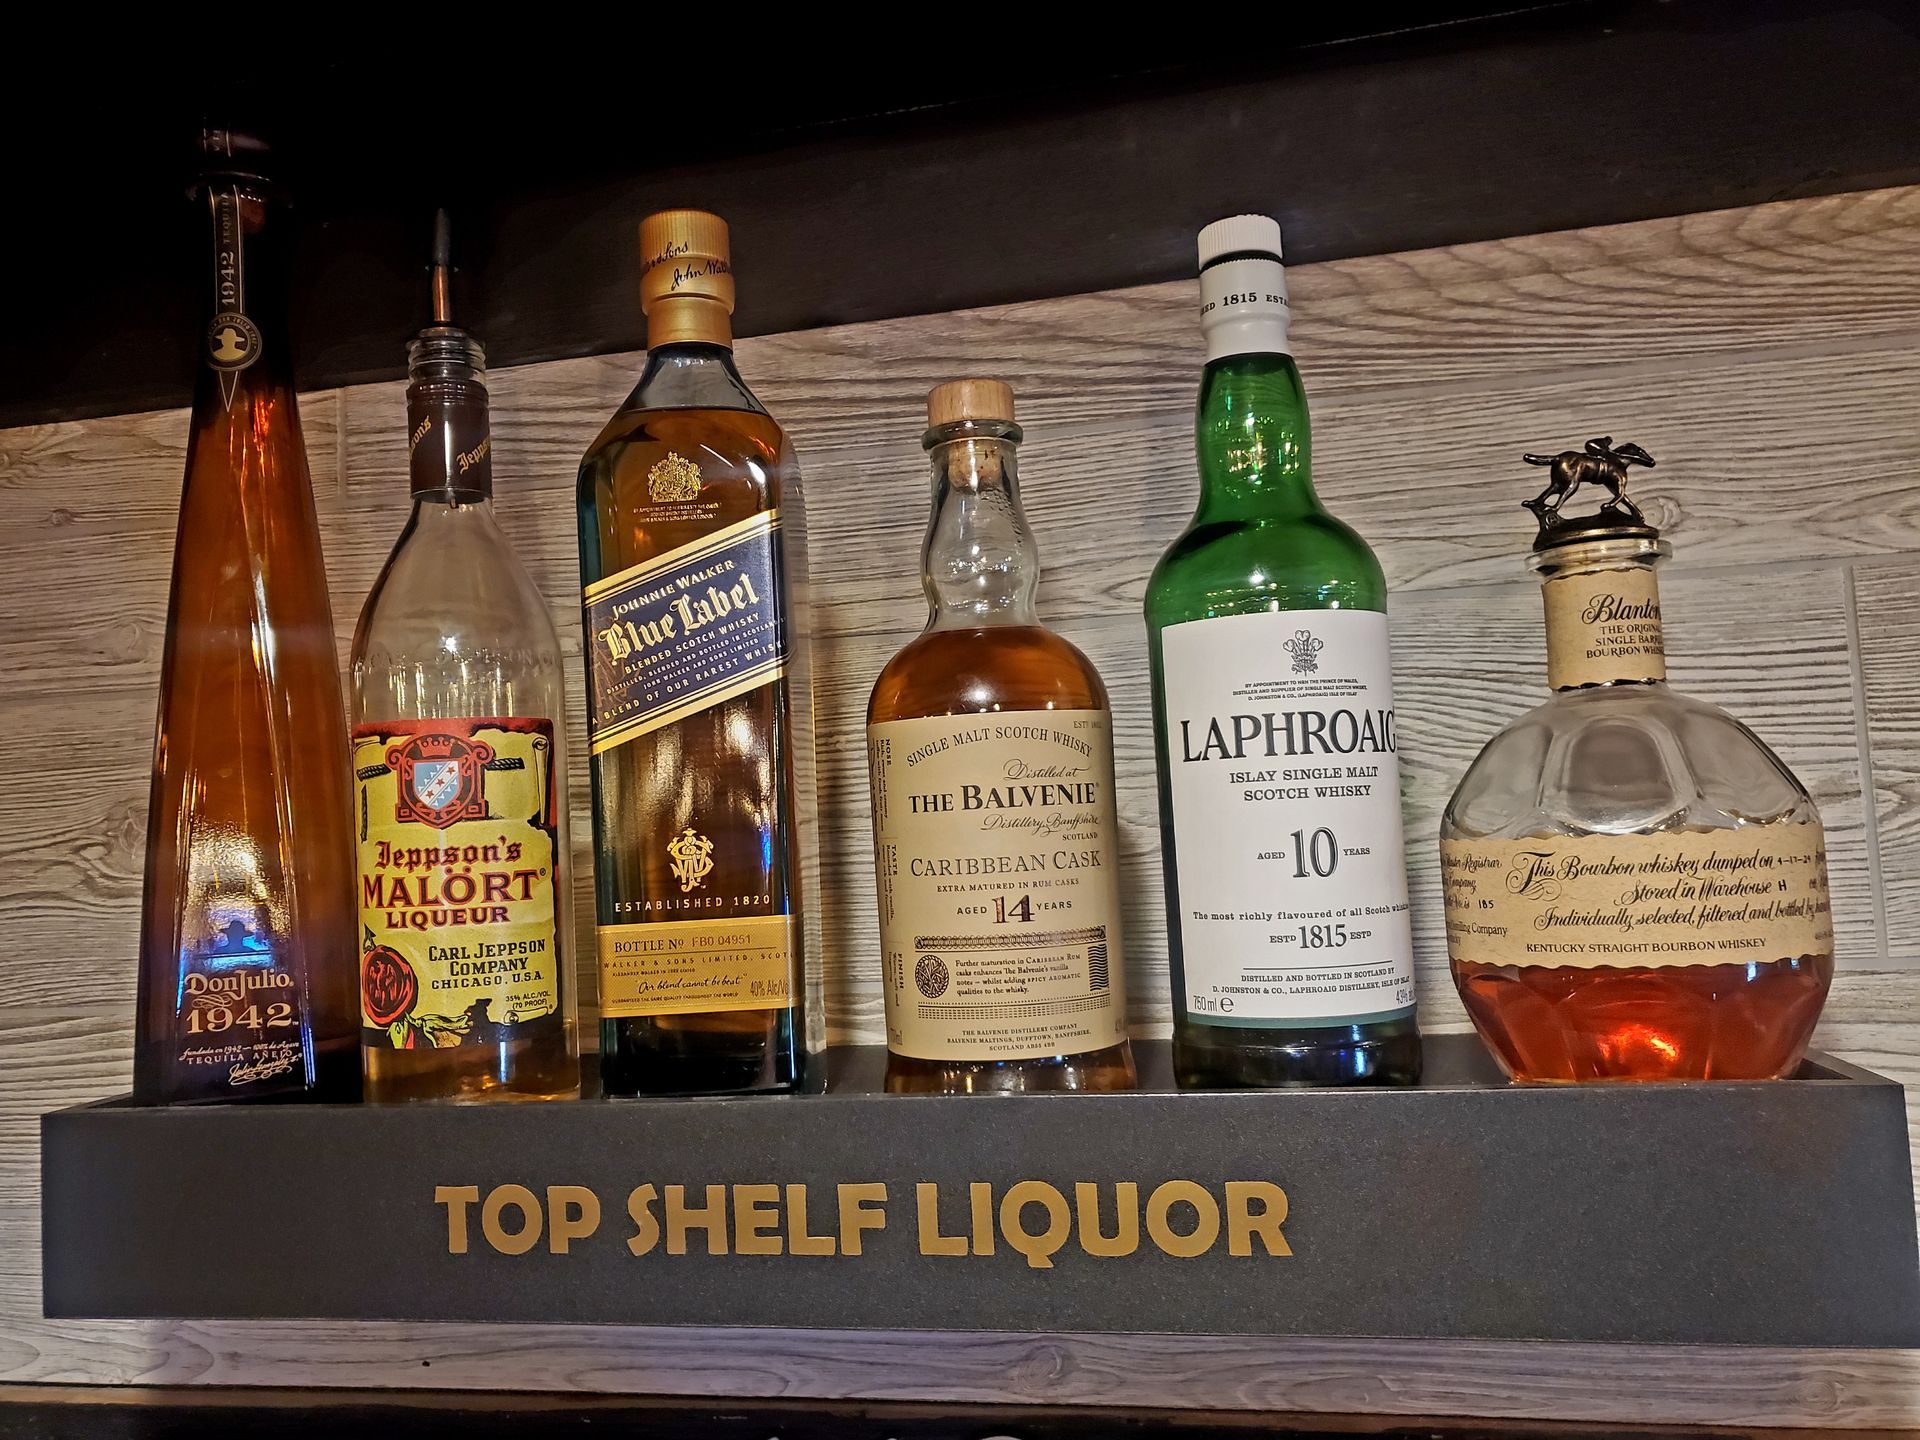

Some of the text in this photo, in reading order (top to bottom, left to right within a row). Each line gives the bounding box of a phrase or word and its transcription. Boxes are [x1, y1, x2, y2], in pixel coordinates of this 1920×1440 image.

[221, 251, 236, 306] 1942
[671, 263, 703, 292] John
[1223, 292, 1257, 307] 1815
[612, 560, 735, 620] JOHNNIE WALKER
[598, 572, 760, 666] Blue Label
[1600, 624, 1624, 635] THE
[624, 612, 760, 674] BLENDED SCOTCH WHISKY
[1596, 635, 1636, 646] SINGLE
[1586, 646, 1640, 659] BOURBON
[648, 660, 680, 677] BLENDED
[604, 699, 640, 720] BLEND
[646, 690, 660, 702] OF
[666, 678, 690, 694] OUR
[696, 658, 738, 682] RAREST
[1180, 708, 1396, 762] LAPHROAIG
[906, 726, 1093, 768] SINGLE MALT SCOTCH WHISKY
[1003, 758, 1090, 780] Distilled at
[1230, 766, 1379, 784] ISLAY SINGLE MALT
[908, 782, 1096, 814] THE BALVENIE
[1244, 784, 1372, 802] SCOTCH WHISKY
[1062, 832, 1098, 840] SCOTLAND
[374, 835, 522, 874] Jeppson's
[1257, 826, 1370, 878] AGED 10 YEARS
[911, 849, 1101, 877] CARIBBEAN CASK
[1556, 856, 1635, 880] Bourbon
[1638, 852, 1700, 880] whiskey
[1702, 848, 1760, 874] dumped
[1760, 854, 1774, 868] on
[362, 866, 540, 909] MALÖRT
[937, 878, 1080, 892] EXTRA MATURED IN RUM CASKS
[1614, 880, 1680, 906] Stored
[1681, 881, 1696, 898] in
[1698, 876, 1772, 901] Warehouse
[1778, 880, 1788, 892] H
[615, 894, 770, 912] ESTABLISHED 1820
[956, 894, 1072, 924] AGED 14 YEARS
[1478, 899, 1494, 909] 185
[386, 906, 510, 932] LIQUEUR
[1193, 904, 1390, 922] The most richly flavoured of all Scotch
[1636, 905, 1696, 926] selected,
[1694, 903, 1749, 929] filtered
[1748, 900, 1775, 922] and
[1269, 924, 1372, 949] ESTD 1815 ESTD
[1472, 922, 1508, 938] Company
[428, 939, 546, 962] CARL JEPPSON
[614, 940, 664, 953] BOTTLE
[1526, 938, 1766, 953] KENTUCKY STRAIGHT BOURBON WHISKEY
[450, 957, 528, 976] COMPANY
[604, 960, 645, 968] WALKER
[666, 958, 694, 966] SONS
[956, 959, 979, 967] Further
[512, 970, 544, 983] U.S.A.
[657, 978, 683, 990] blend
[682, 978, 708, 988] cannot
[712, 975, 720, 986] be
[1004, 977, 1026, 985] adding
[1306, 972, 1342, 982] BOTTLED
[1344, 972, 1353, 980] IN
[1354, 968, 1387, 978] SCOTLAND
[1220, 986, 1261, 994] JOHNSTON
[1289, 985, 1337, 994] LAPHROAIG
[1193, 994, 1217, 1012] 750 ml
[186, 1002, 292, 1034] 1942
[186, 1048, 292, 1065] TEQUILA AÑEJO
[224, 1045, 242, 1054] 1942
[434, 1180, 1294, 1270] TOP SHELF LIQUOR
